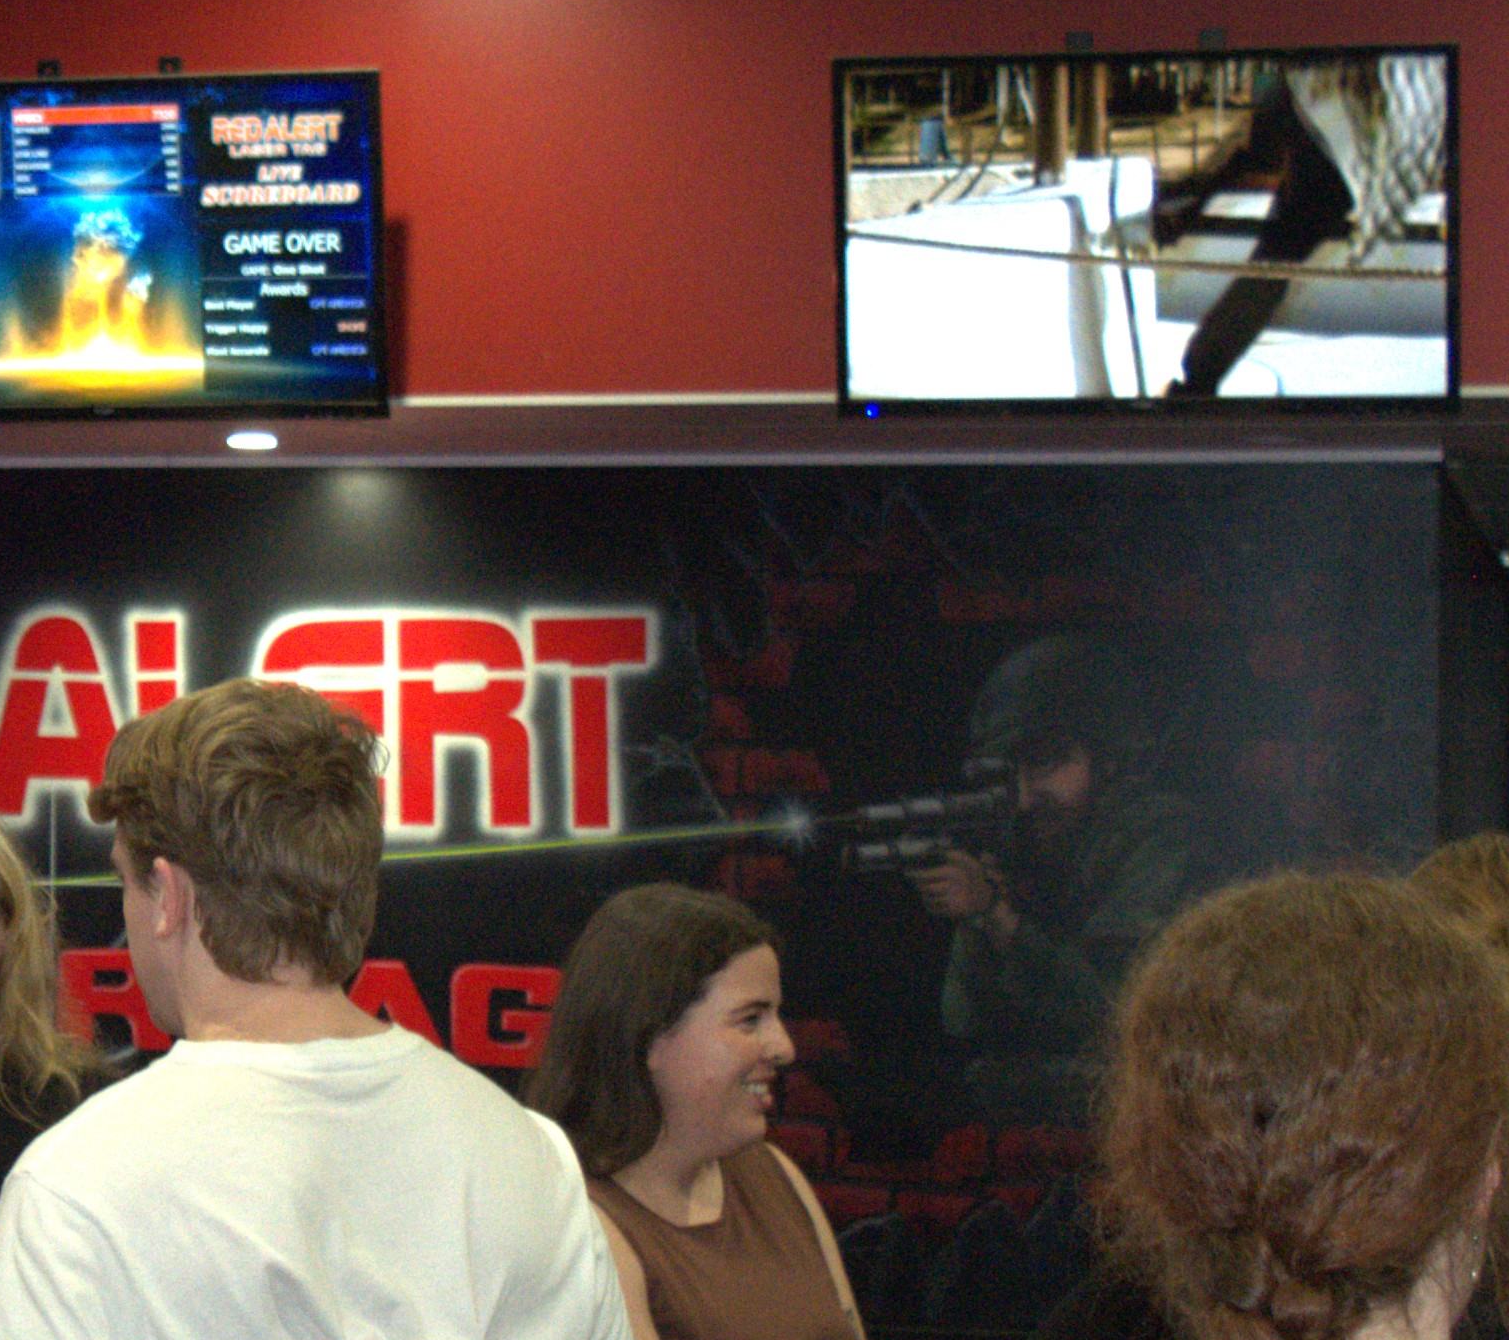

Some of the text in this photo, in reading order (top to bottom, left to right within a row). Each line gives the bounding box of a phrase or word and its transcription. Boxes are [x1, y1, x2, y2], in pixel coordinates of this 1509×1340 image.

[212, 113, 343, 145] RED ALERT
[229, 142, 328, 158] LASER TAG
[258, 163, 303, 183] LIVE
[201, 182, 361, 207] SCOREBOARD
[223, 231, 342, 255] GAME OVER
[272, 263, 297, 276] One
[298, 262, 326, 275] Shot
[259, 282, 309, 297] Awards
